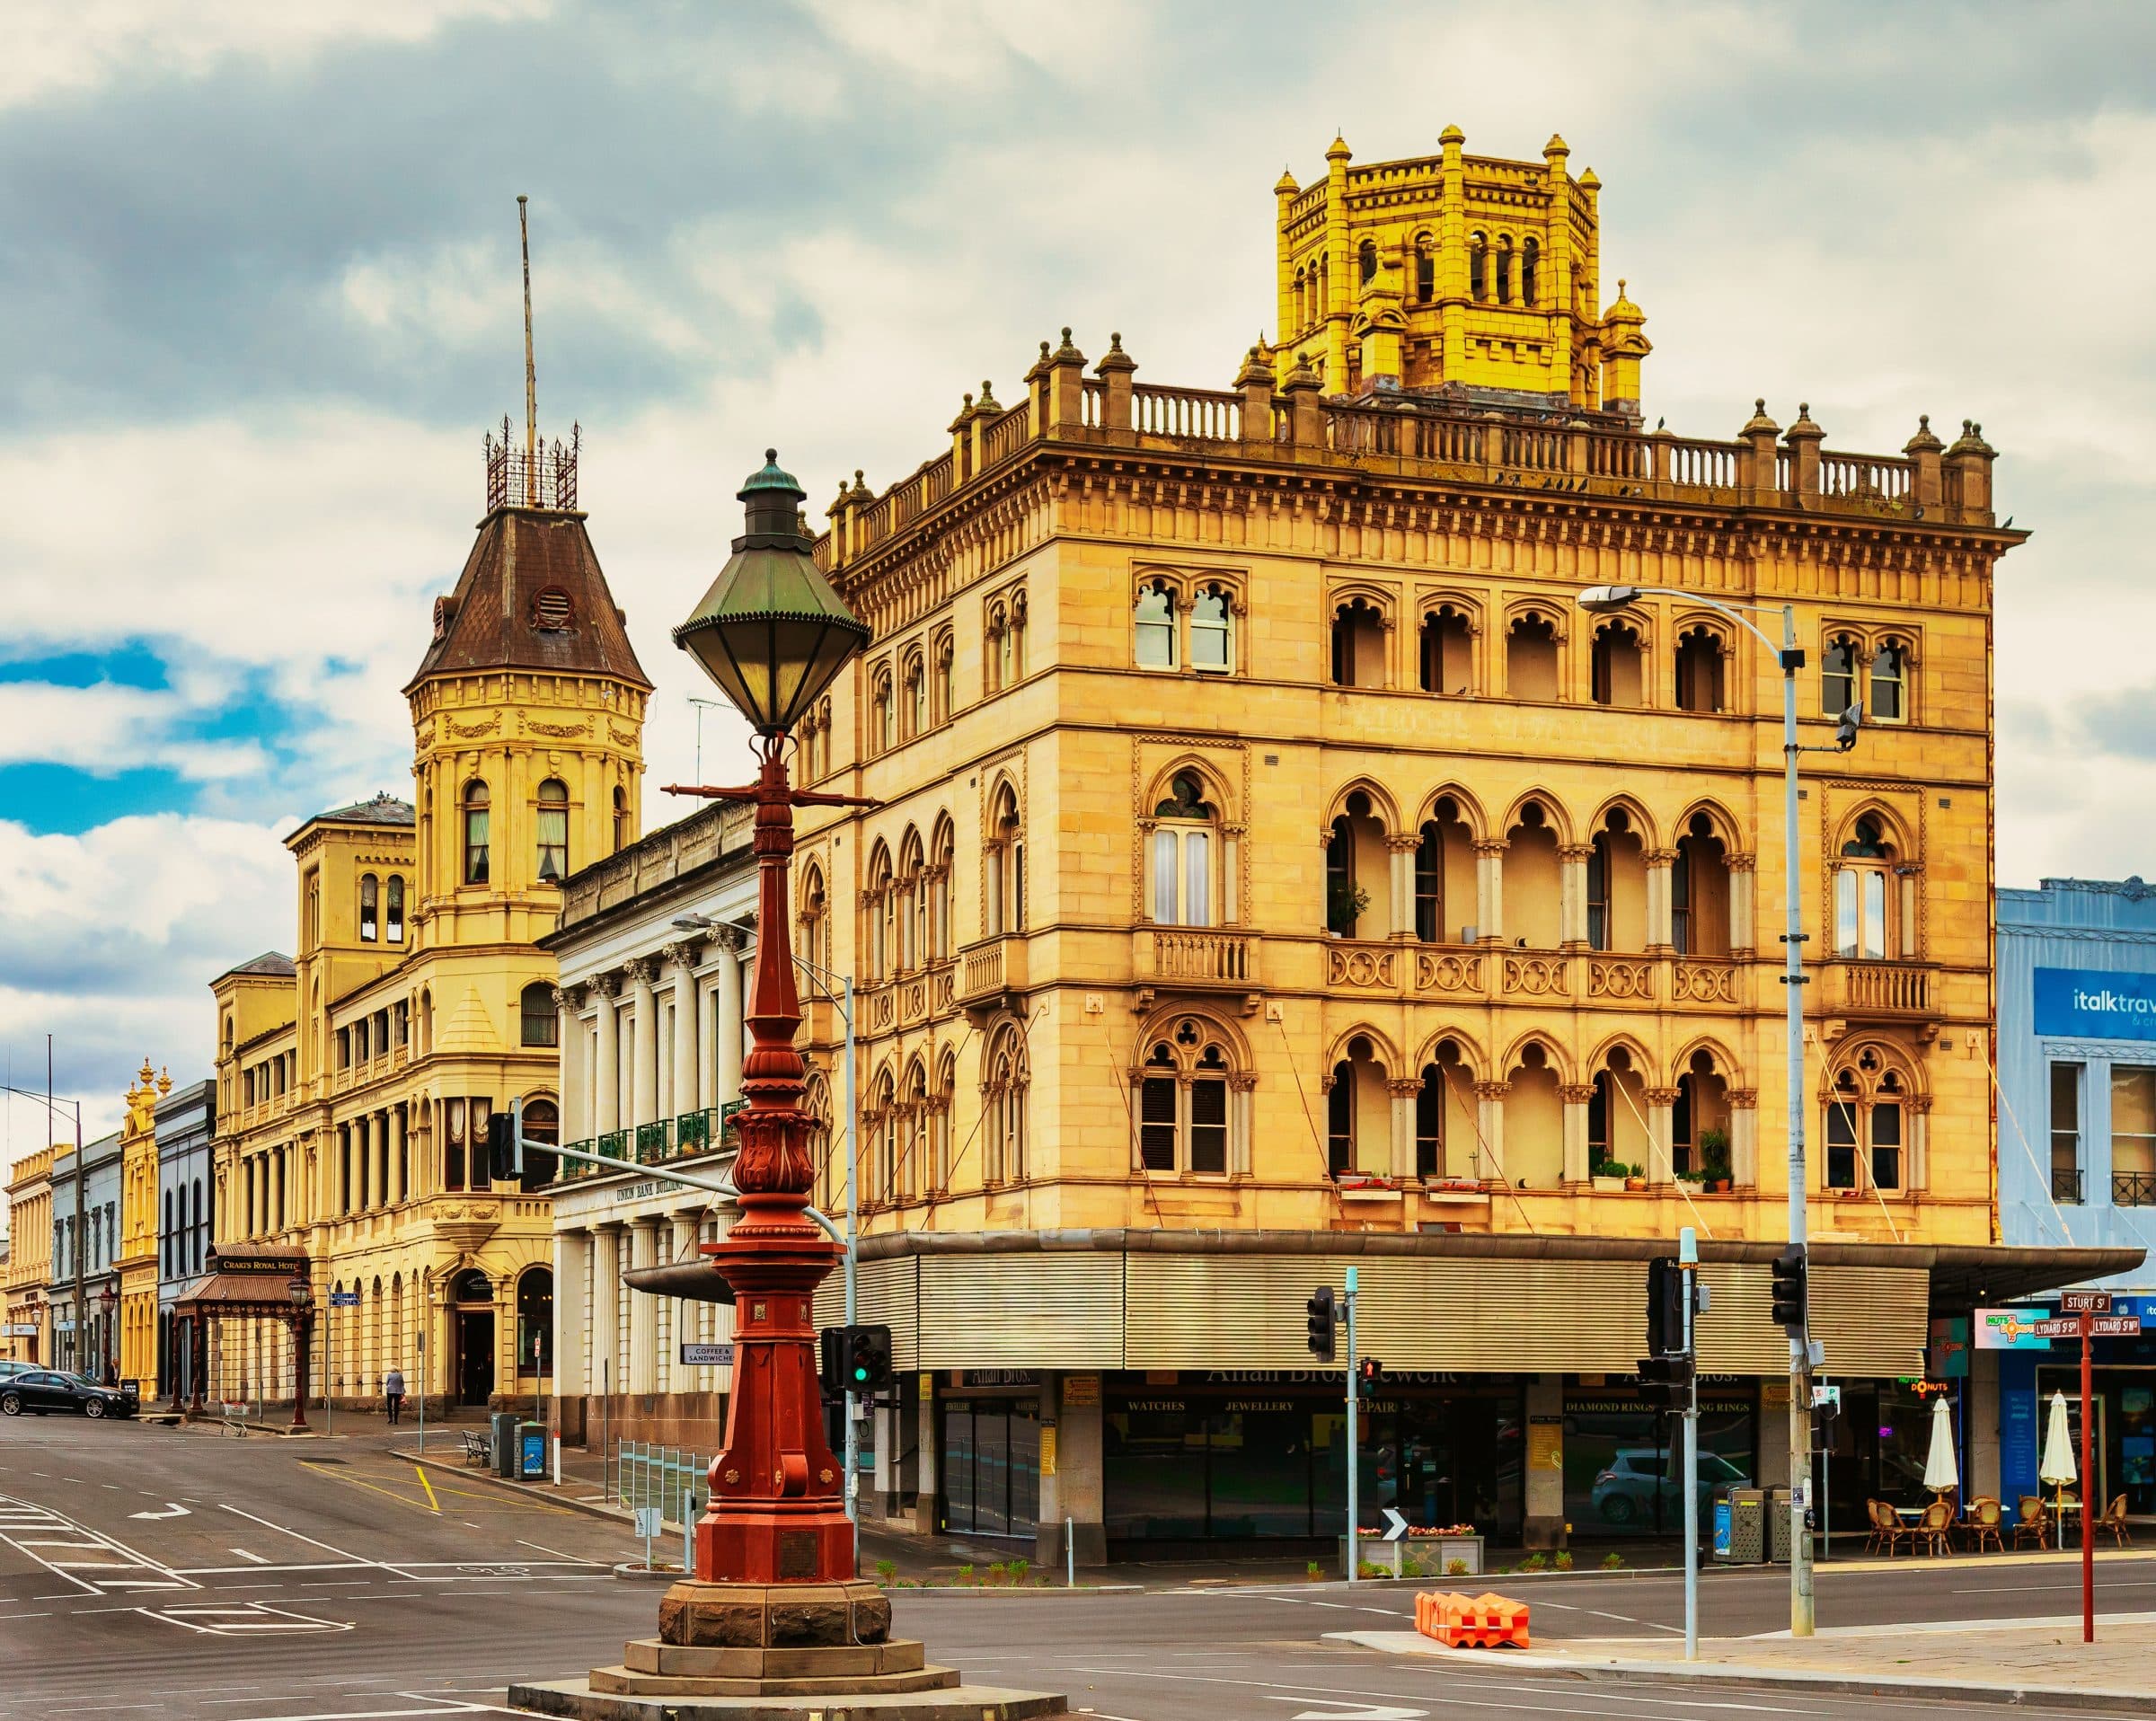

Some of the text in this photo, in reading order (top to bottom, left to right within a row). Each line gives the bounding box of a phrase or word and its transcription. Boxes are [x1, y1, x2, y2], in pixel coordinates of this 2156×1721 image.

[617, 1187, 634, 1202] UNION
[637, 1183, 653, 1198] BANK
[253, 1261, 277, 1269] ROYAL
[2067, 1296, 2095, 1310] STURT
[1987, 1316, 2009, 1325] NUTS
[2095, 1320, 2121, 1332] LYDIARD
[2036, 1322, 2061, 1336] LYDIARD
[1911, 1381, 1948, 1393] DONUTS
[1128, 1401, 1186, 1411] WATCHES
[1225, 1401, 1294, 1412] JEWELLERY
[1566, 1402, 1655, 1412] DIAMOND RINGS
[1717, 1402, 1750, 1412] RINGS
